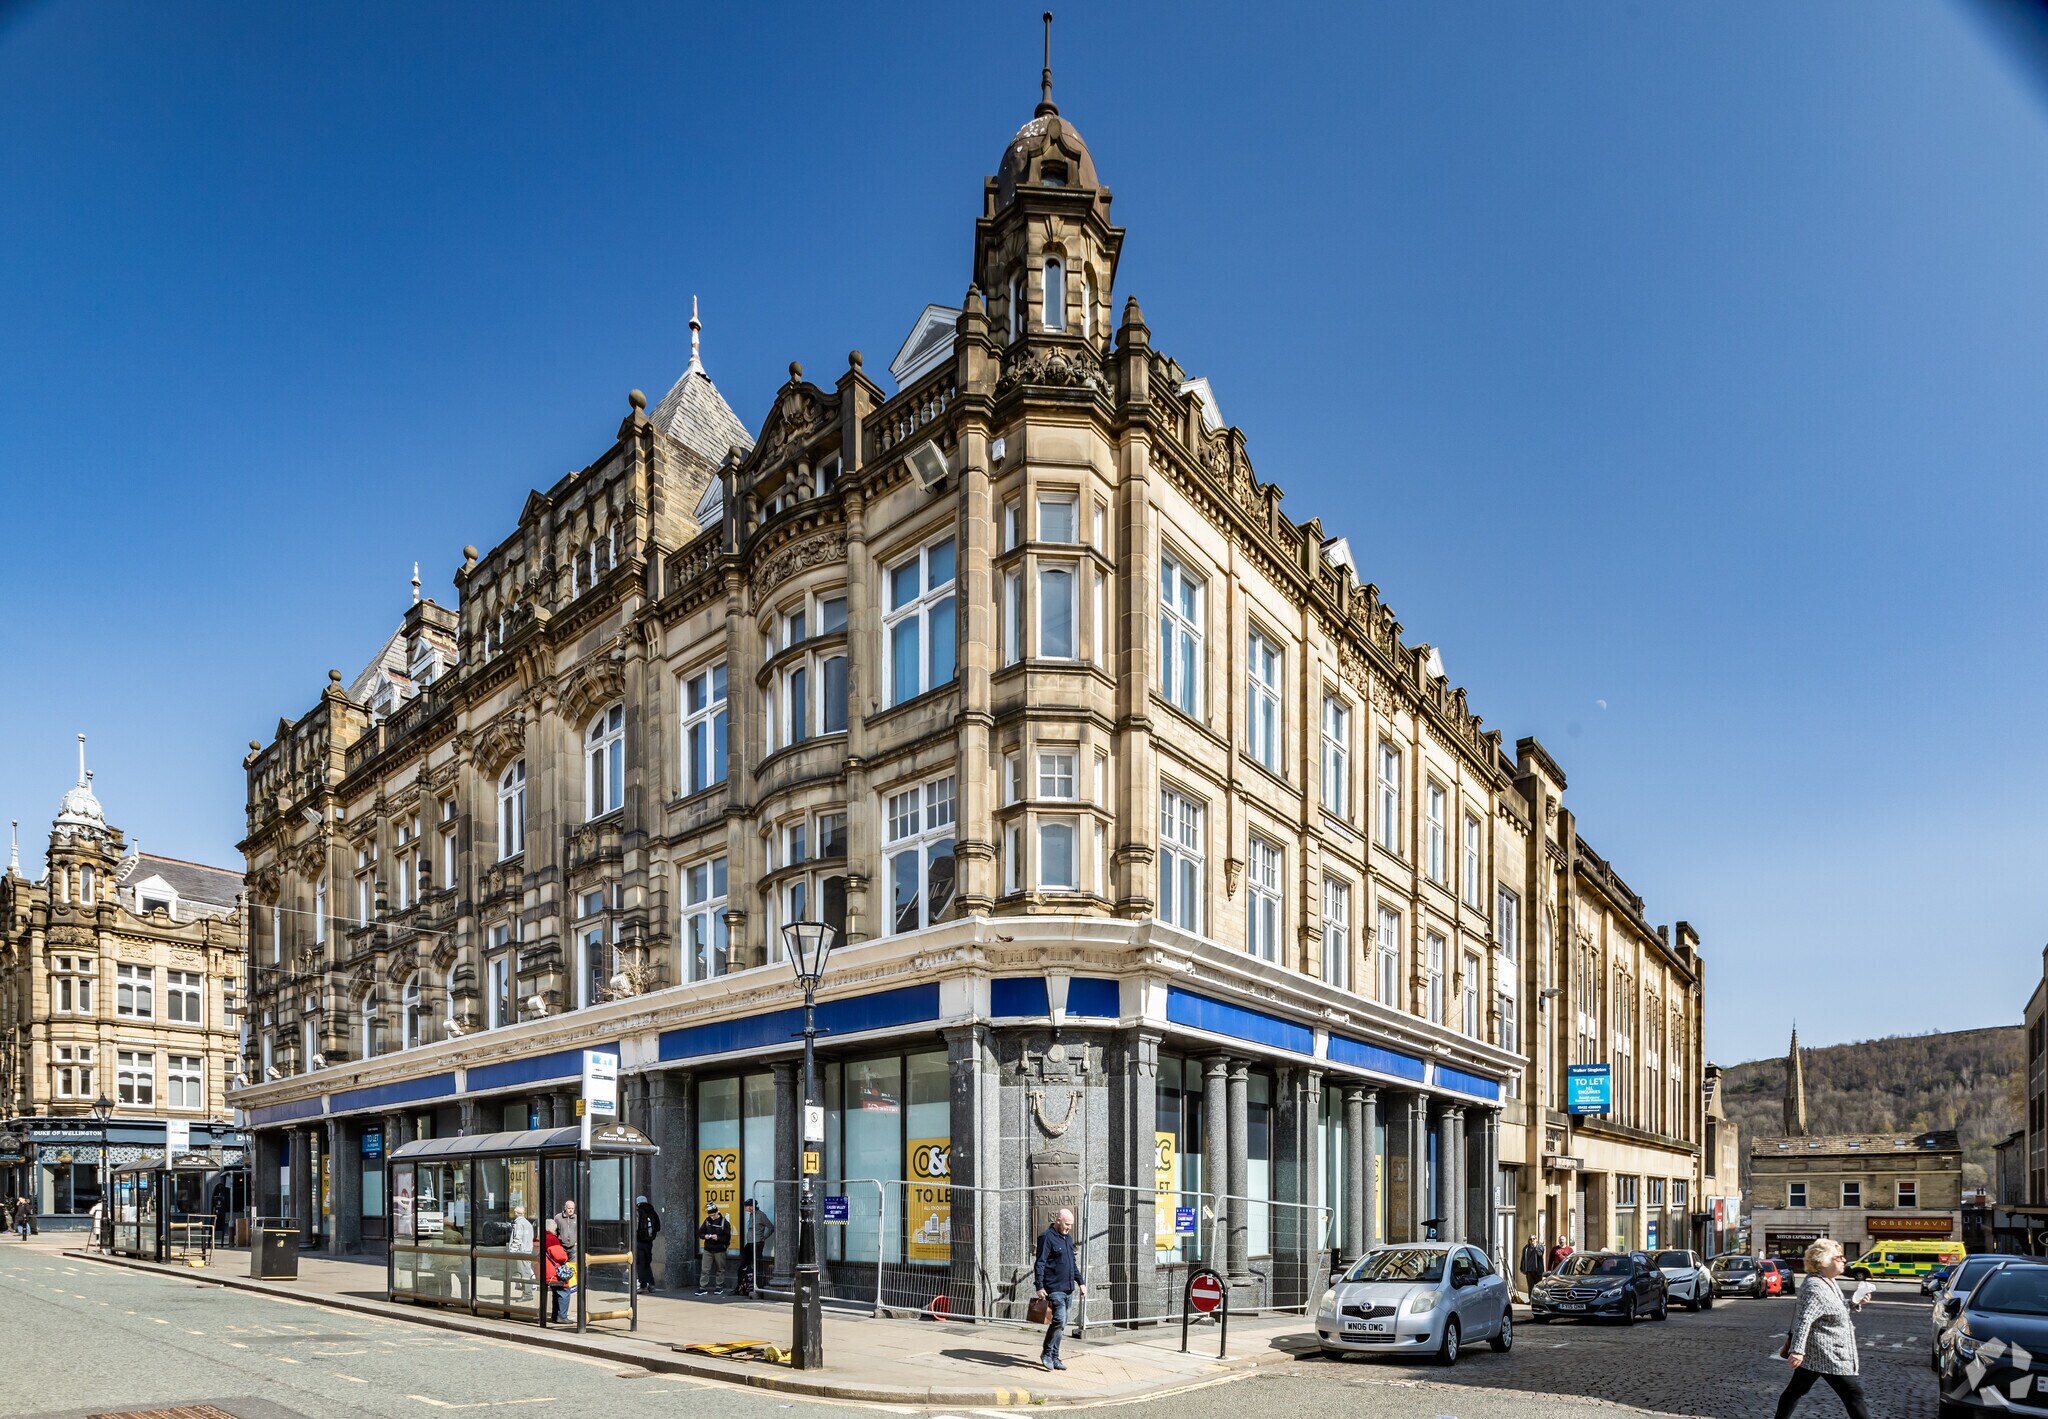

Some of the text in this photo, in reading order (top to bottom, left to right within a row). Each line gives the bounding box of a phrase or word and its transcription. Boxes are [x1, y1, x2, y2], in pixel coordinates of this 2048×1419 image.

[1574, 1077, 1604, 1086] TO LET
[806, 1153, 817, 1170] H
[703, 1154, 737, 1182] O&C
[705, 1190, 735, 1203] TO LET
[915, 1189, 951, 1203] TO LE
[1034, 1195, 1078, 1206] PERMANENT
[1430, 1228, 1437, 1238] P
[1347, 1322, 1384, 1332] WN06 OWG
